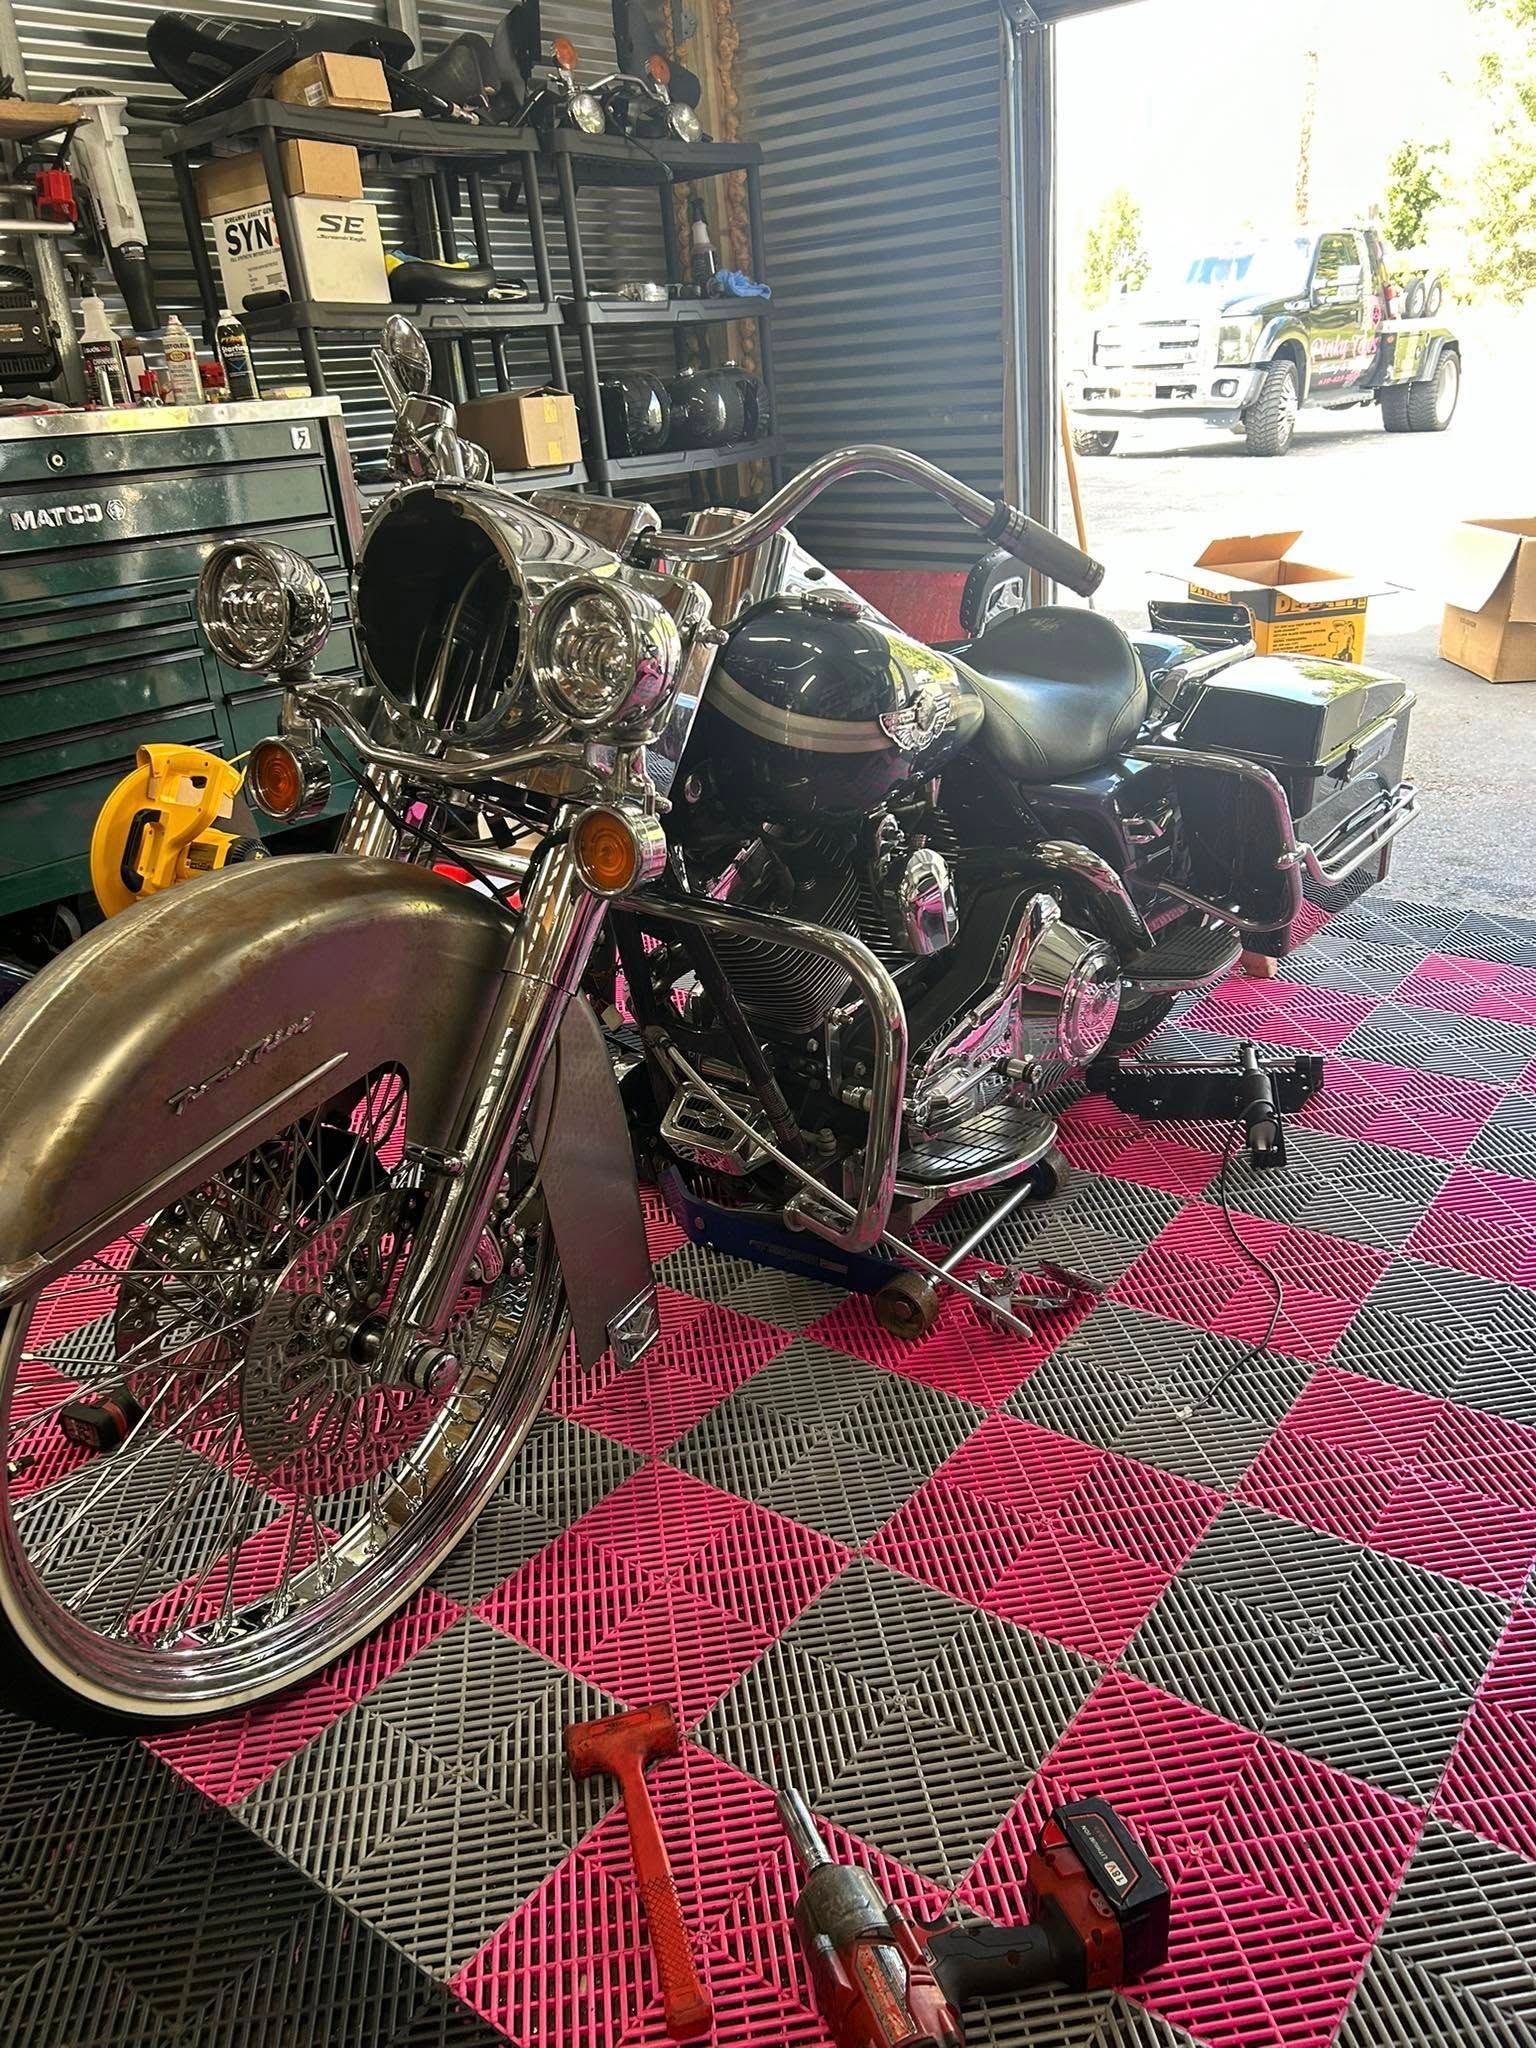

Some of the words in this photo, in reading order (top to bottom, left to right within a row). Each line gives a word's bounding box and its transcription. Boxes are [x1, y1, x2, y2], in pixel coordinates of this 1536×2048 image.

[316, 214, 365, 235] SE
[9, 502, 104, 531] MATCO
[1106, 1864, 1124, 1883] 18V
